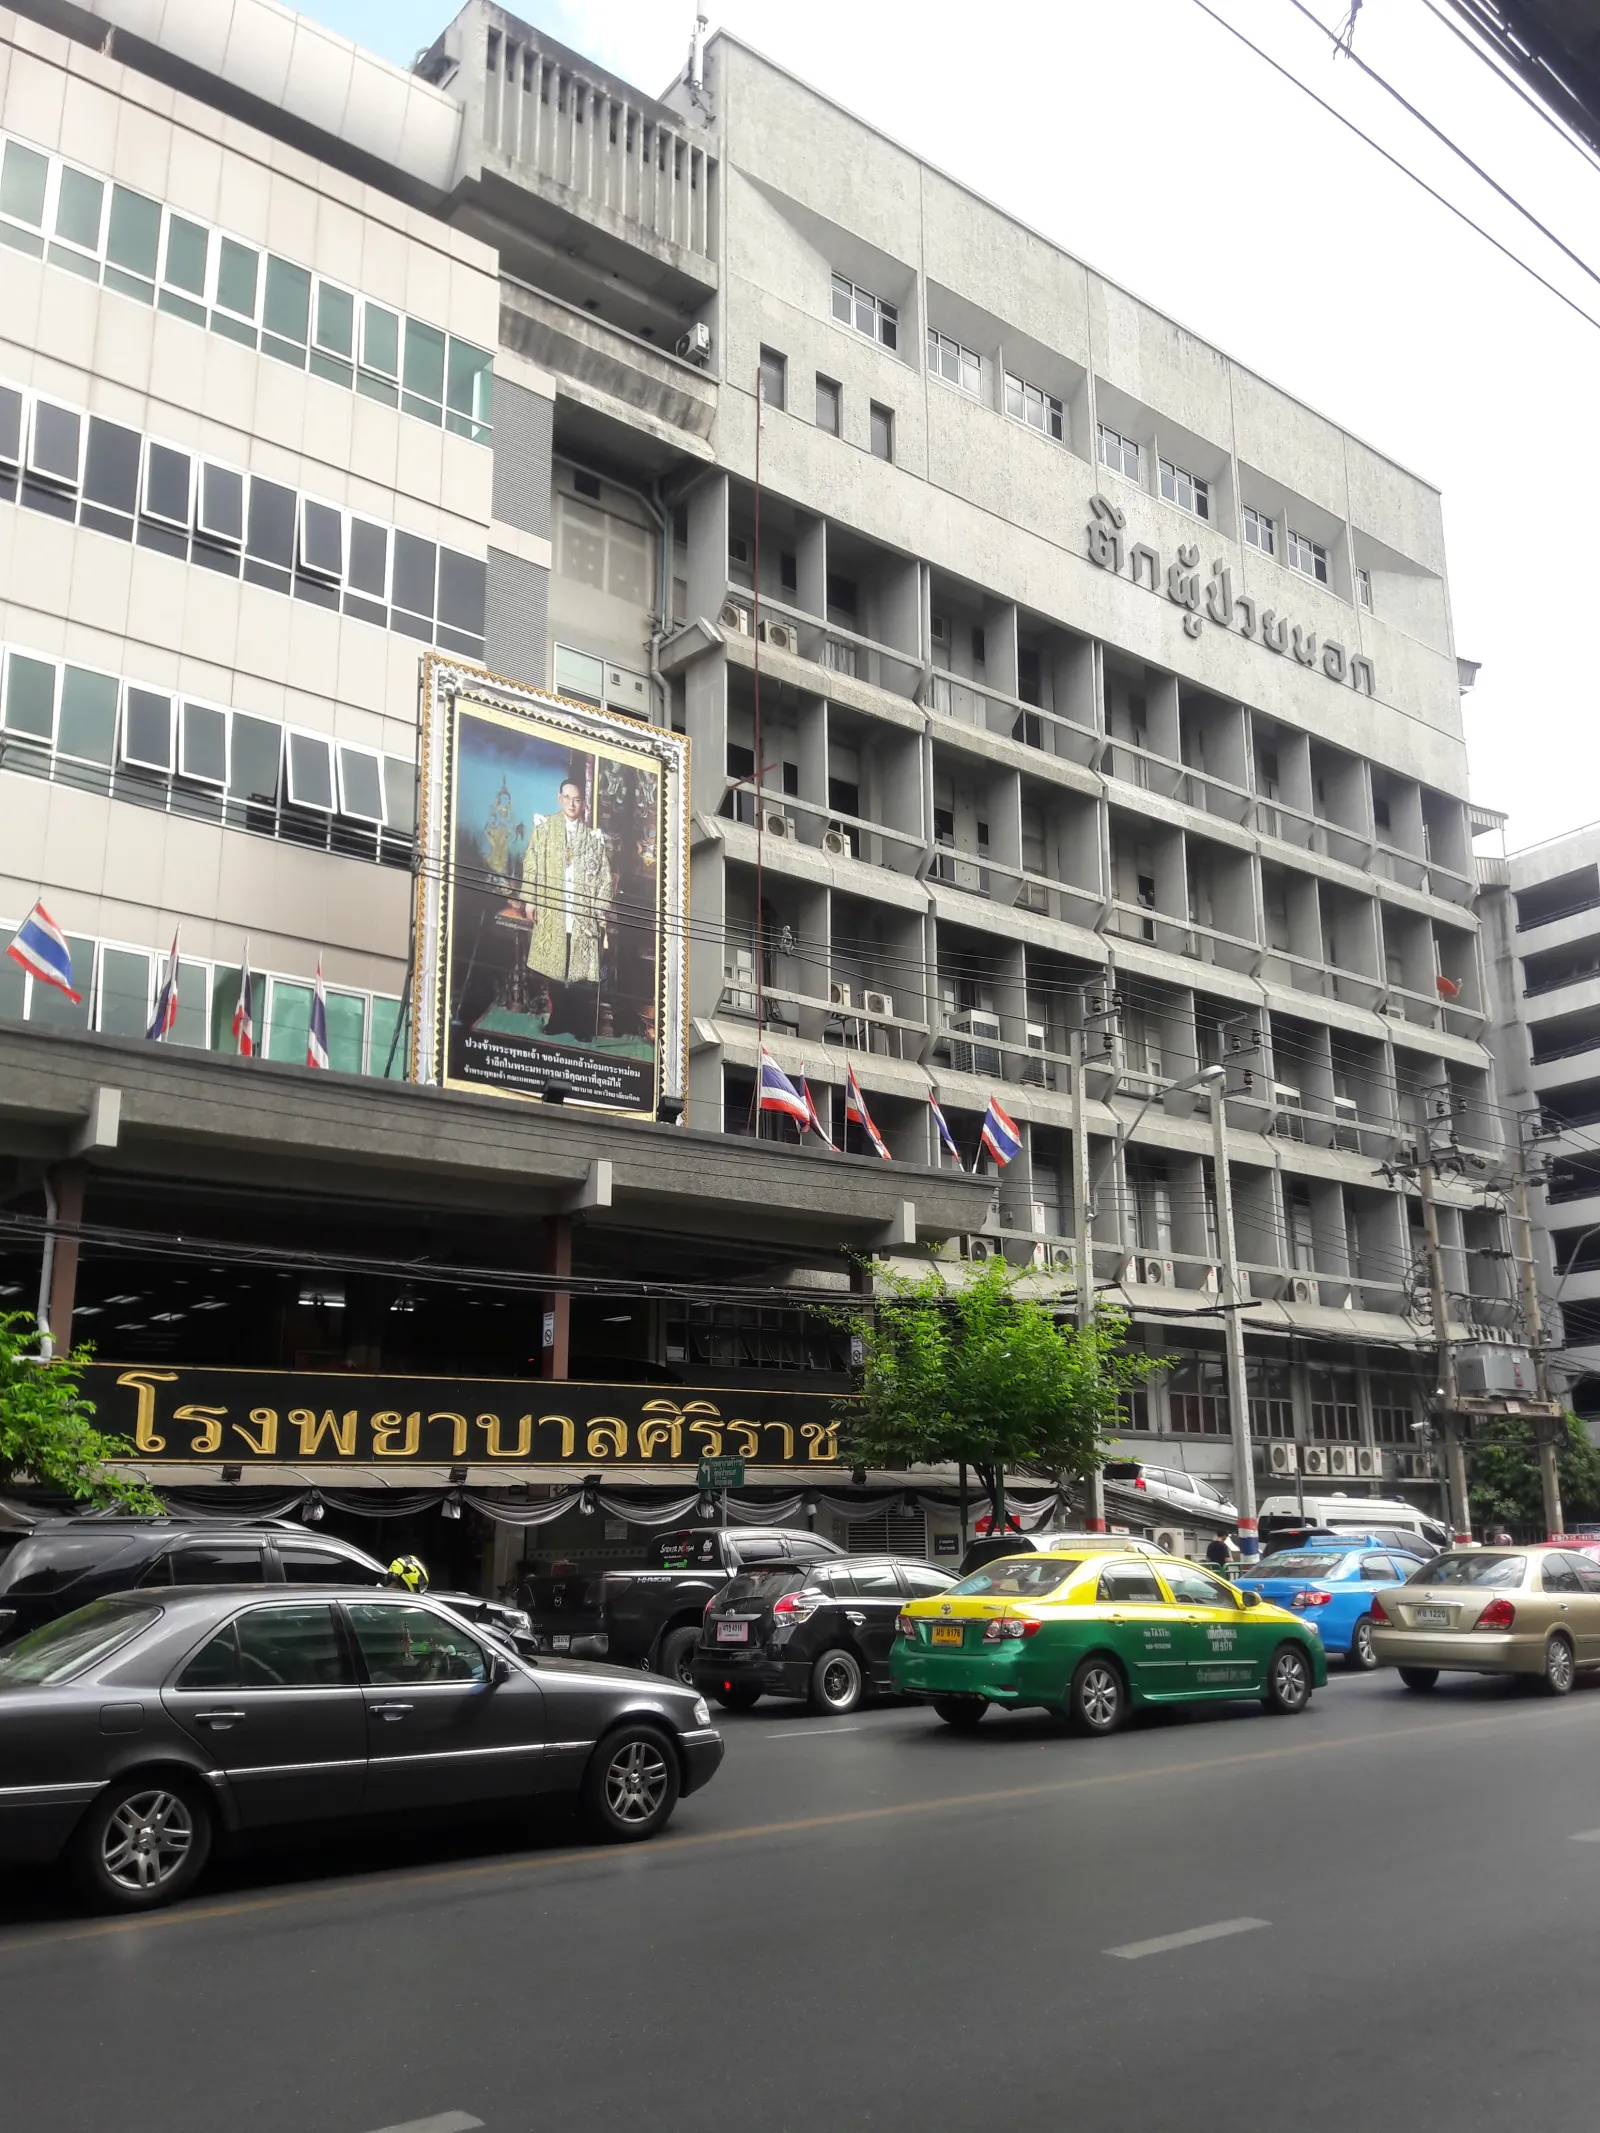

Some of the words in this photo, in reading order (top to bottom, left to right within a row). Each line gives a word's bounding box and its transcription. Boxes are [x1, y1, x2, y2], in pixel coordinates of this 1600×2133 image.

[1087, 493, 1376, 695] ตึกผู้ป่วยนอก
[115, 1371, 841, 1461] โรงพยาบาลศิริราช
[947, 1629, 961, 1638] 9176
